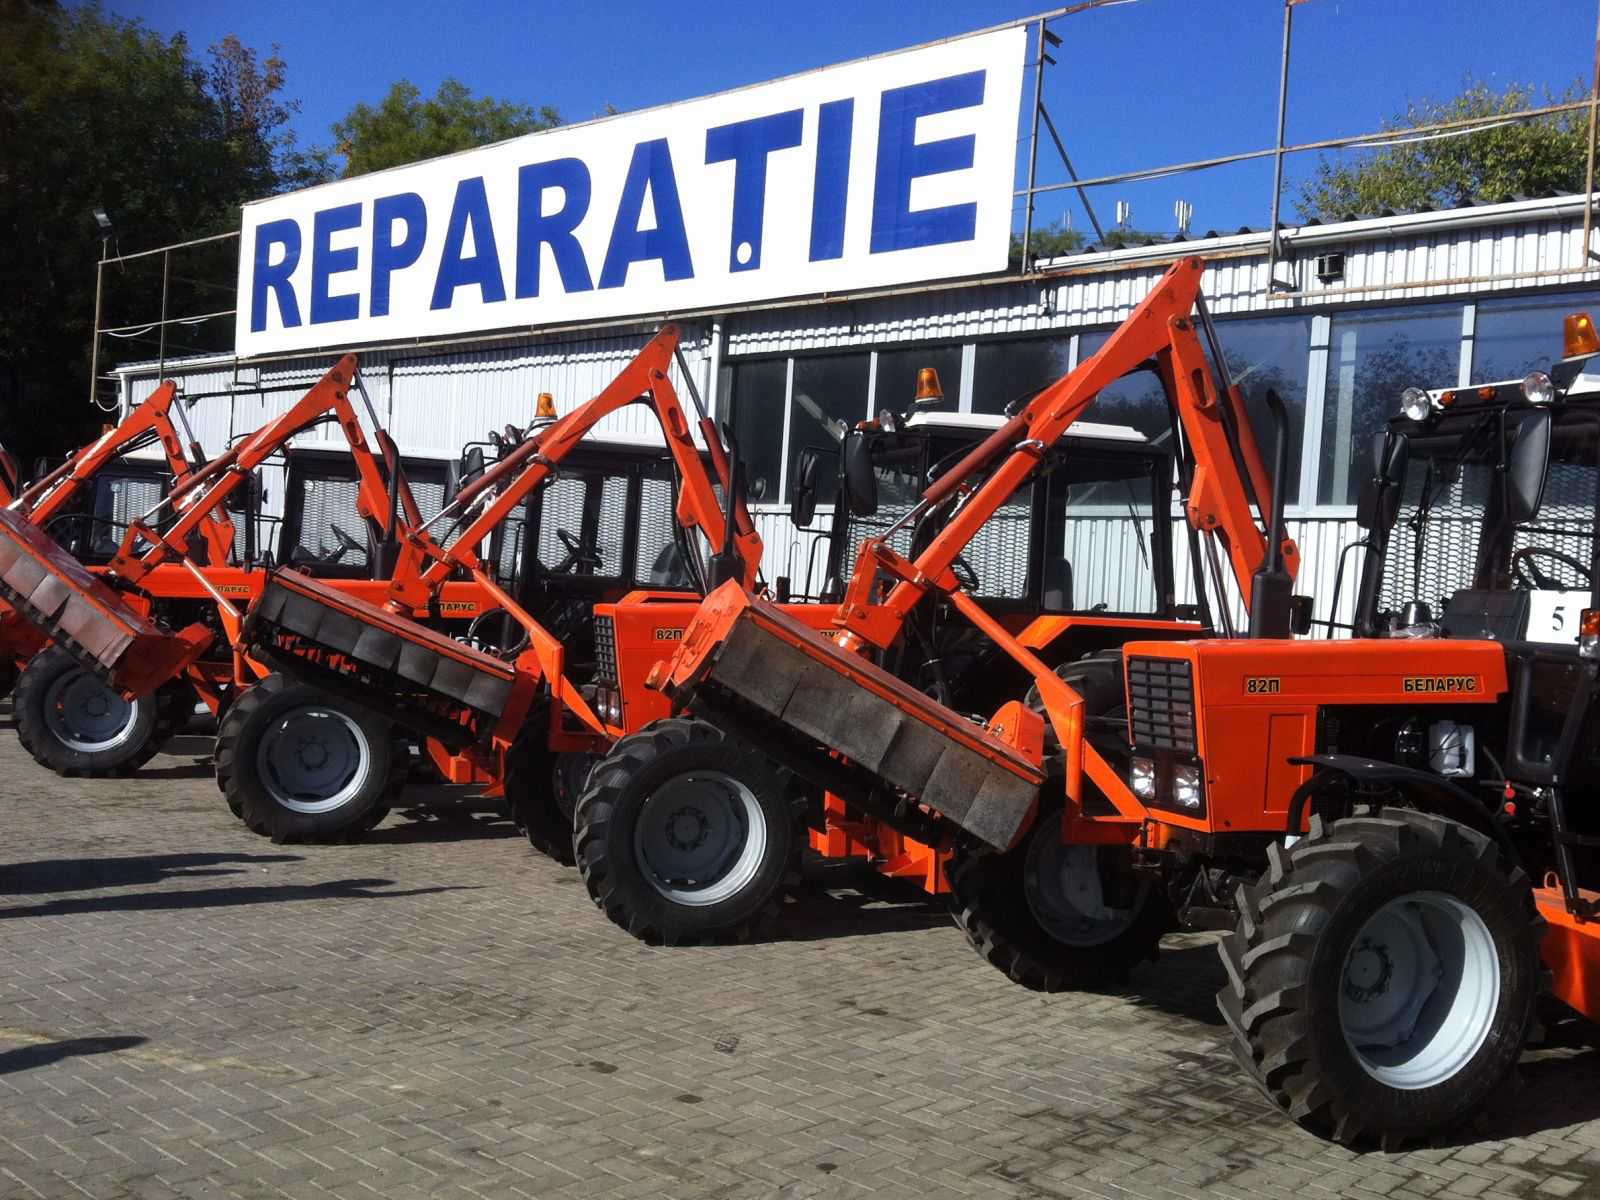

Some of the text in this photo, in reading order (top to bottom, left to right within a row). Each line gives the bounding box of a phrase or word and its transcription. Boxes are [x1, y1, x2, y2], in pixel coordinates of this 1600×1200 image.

[250, 69, 987, 333] REPARATIE
[1552, 606, 1565, 631] 5
[1247, 679, 1280, 693] 82П
[1404, 678, 1475, 692] БЕЛАРУС
